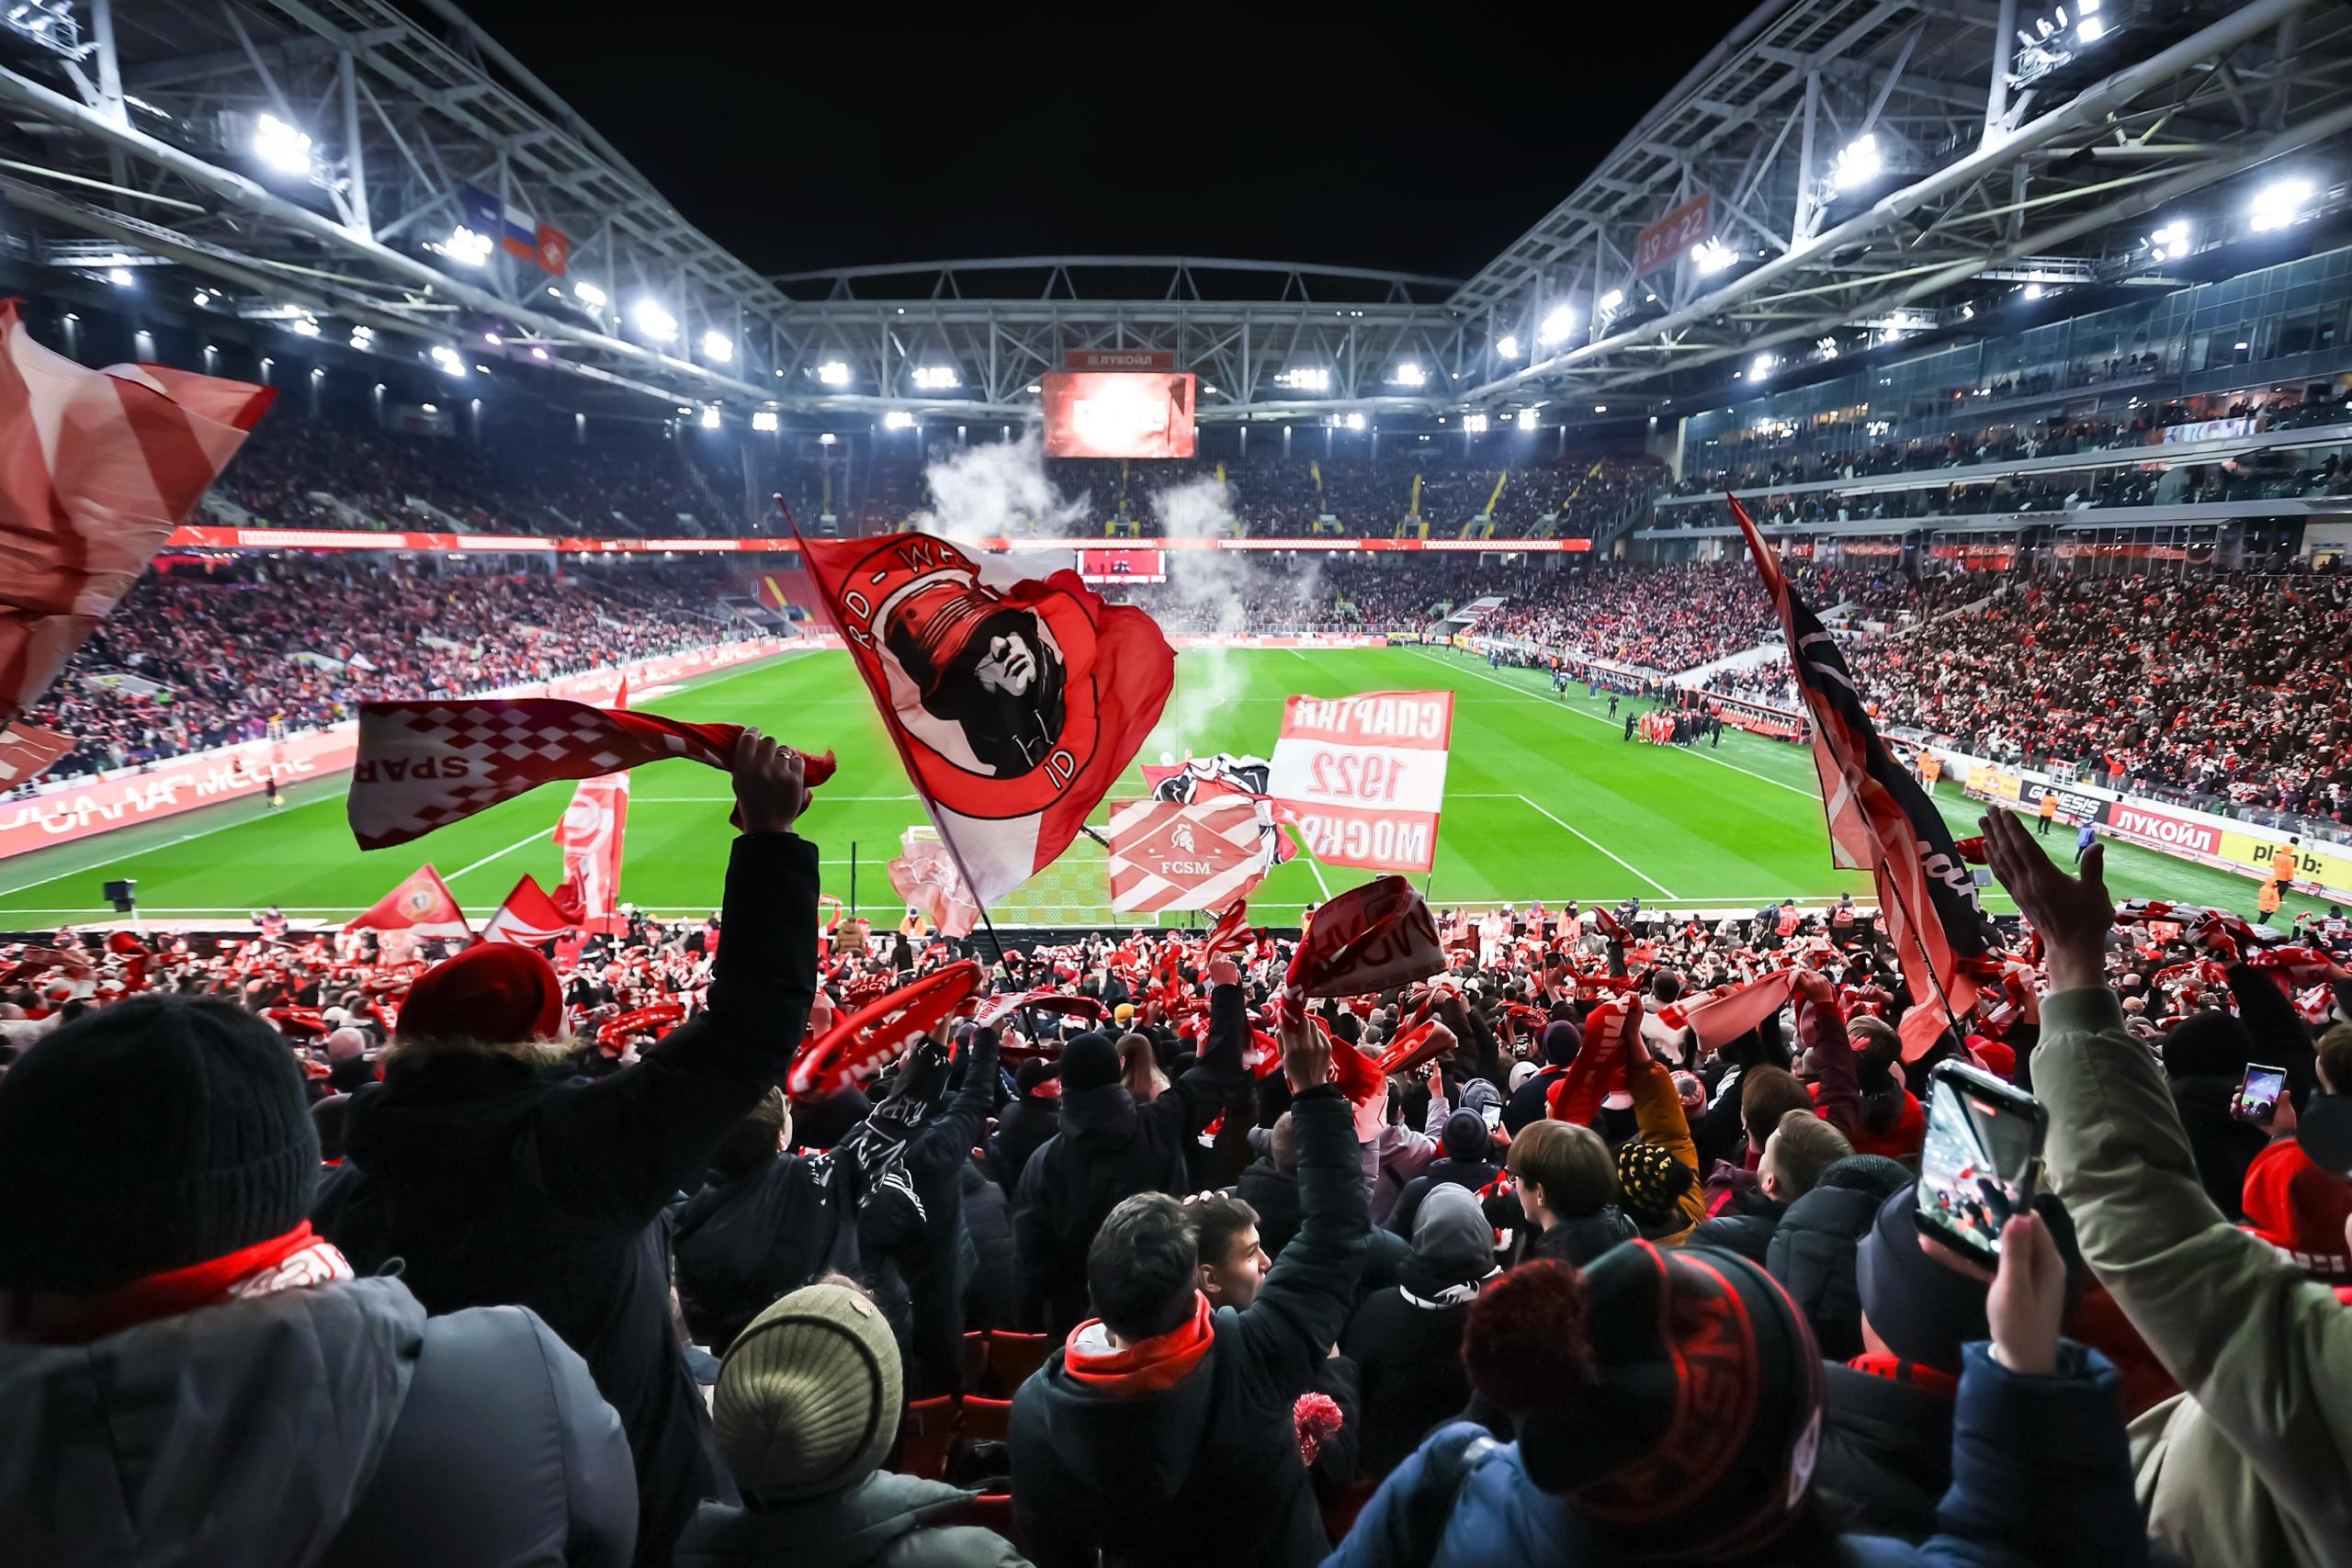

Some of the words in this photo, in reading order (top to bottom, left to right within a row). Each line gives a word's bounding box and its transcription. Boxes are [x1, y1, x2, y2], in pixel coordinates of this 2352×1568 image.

[1679, 208, 1703, 243] 22
[1101, 353, 1152, 366] ЛУКОЙЛ
[2116, 810, 2212, 852] ЛУКОЙЛ
[2253, 844, 2298, 863] pln
[1160, 861, 1212, 874] FCSM
